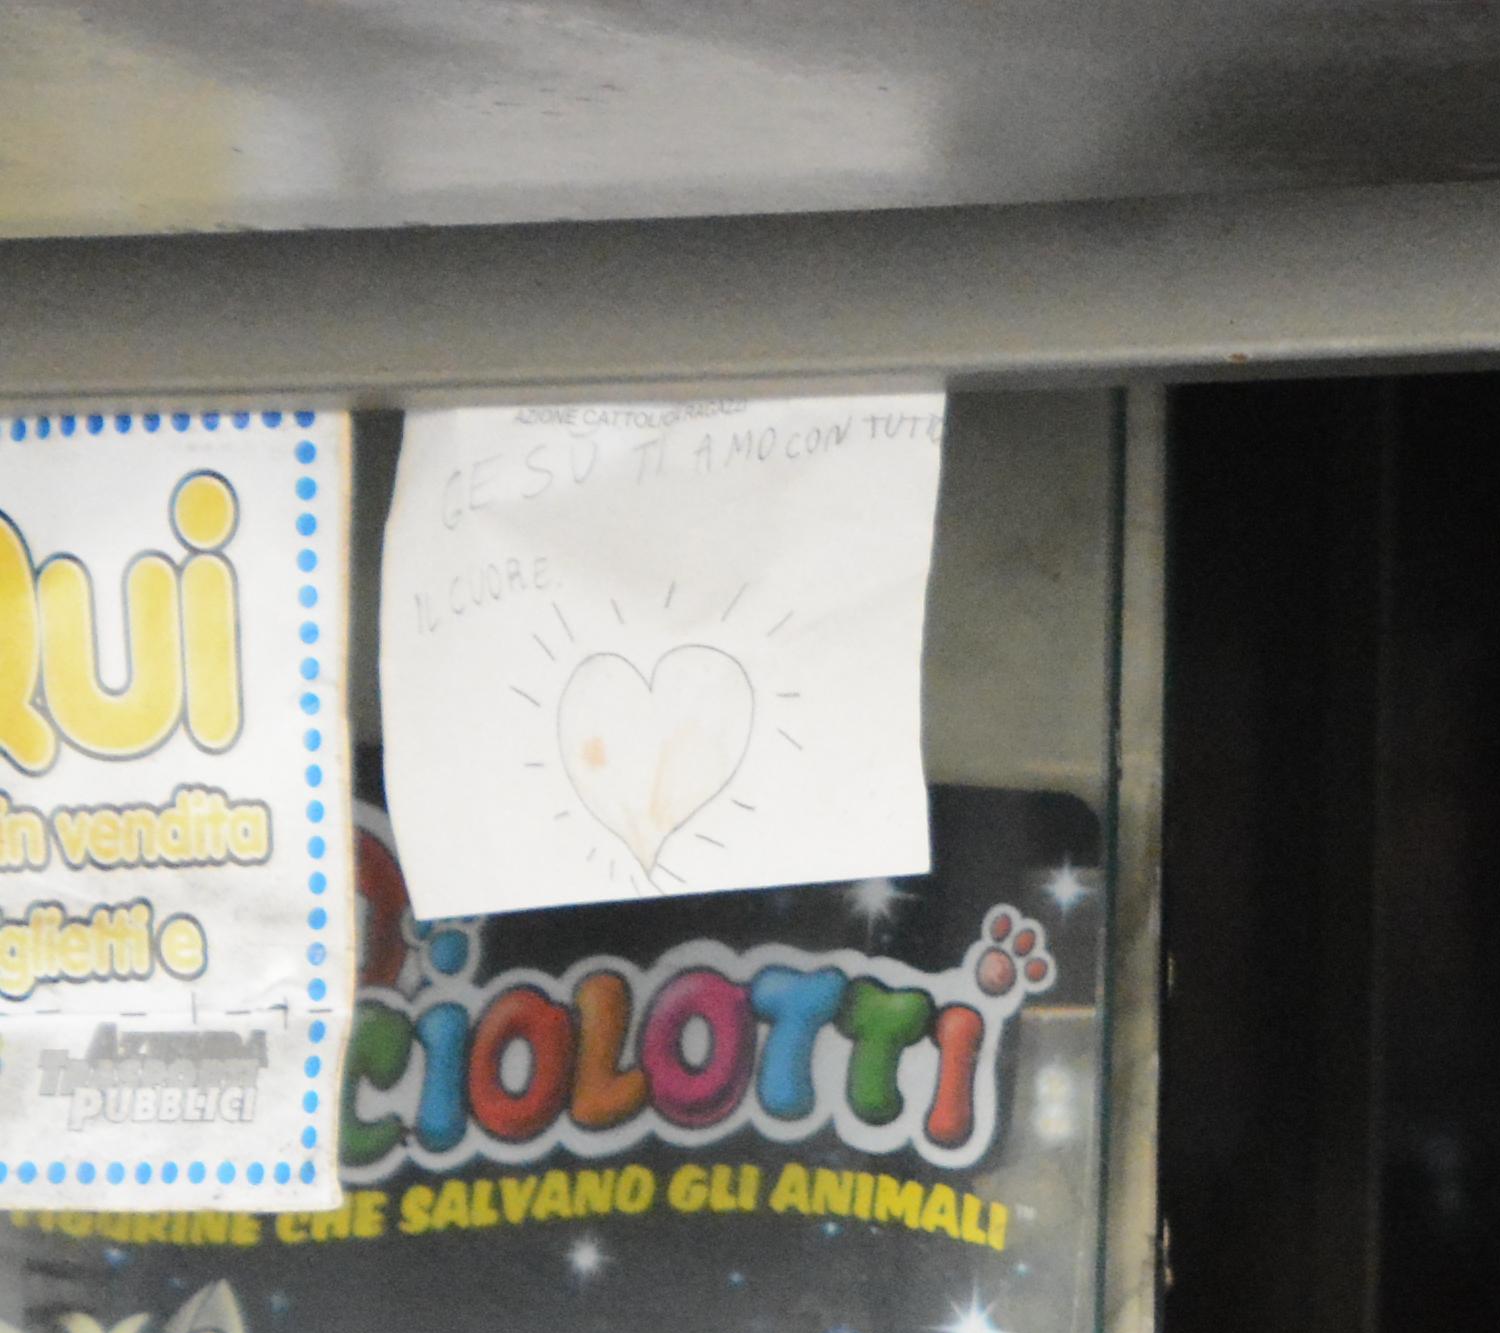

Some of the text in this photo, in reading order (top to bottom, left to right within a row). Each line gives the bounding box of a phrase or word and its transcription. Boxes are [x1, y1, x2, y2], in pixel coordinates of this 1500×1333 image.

[786, 412, 846, 458] CON
[275, 1162, 1006, 1249] CHE SALVANO GLI ANIMALI
